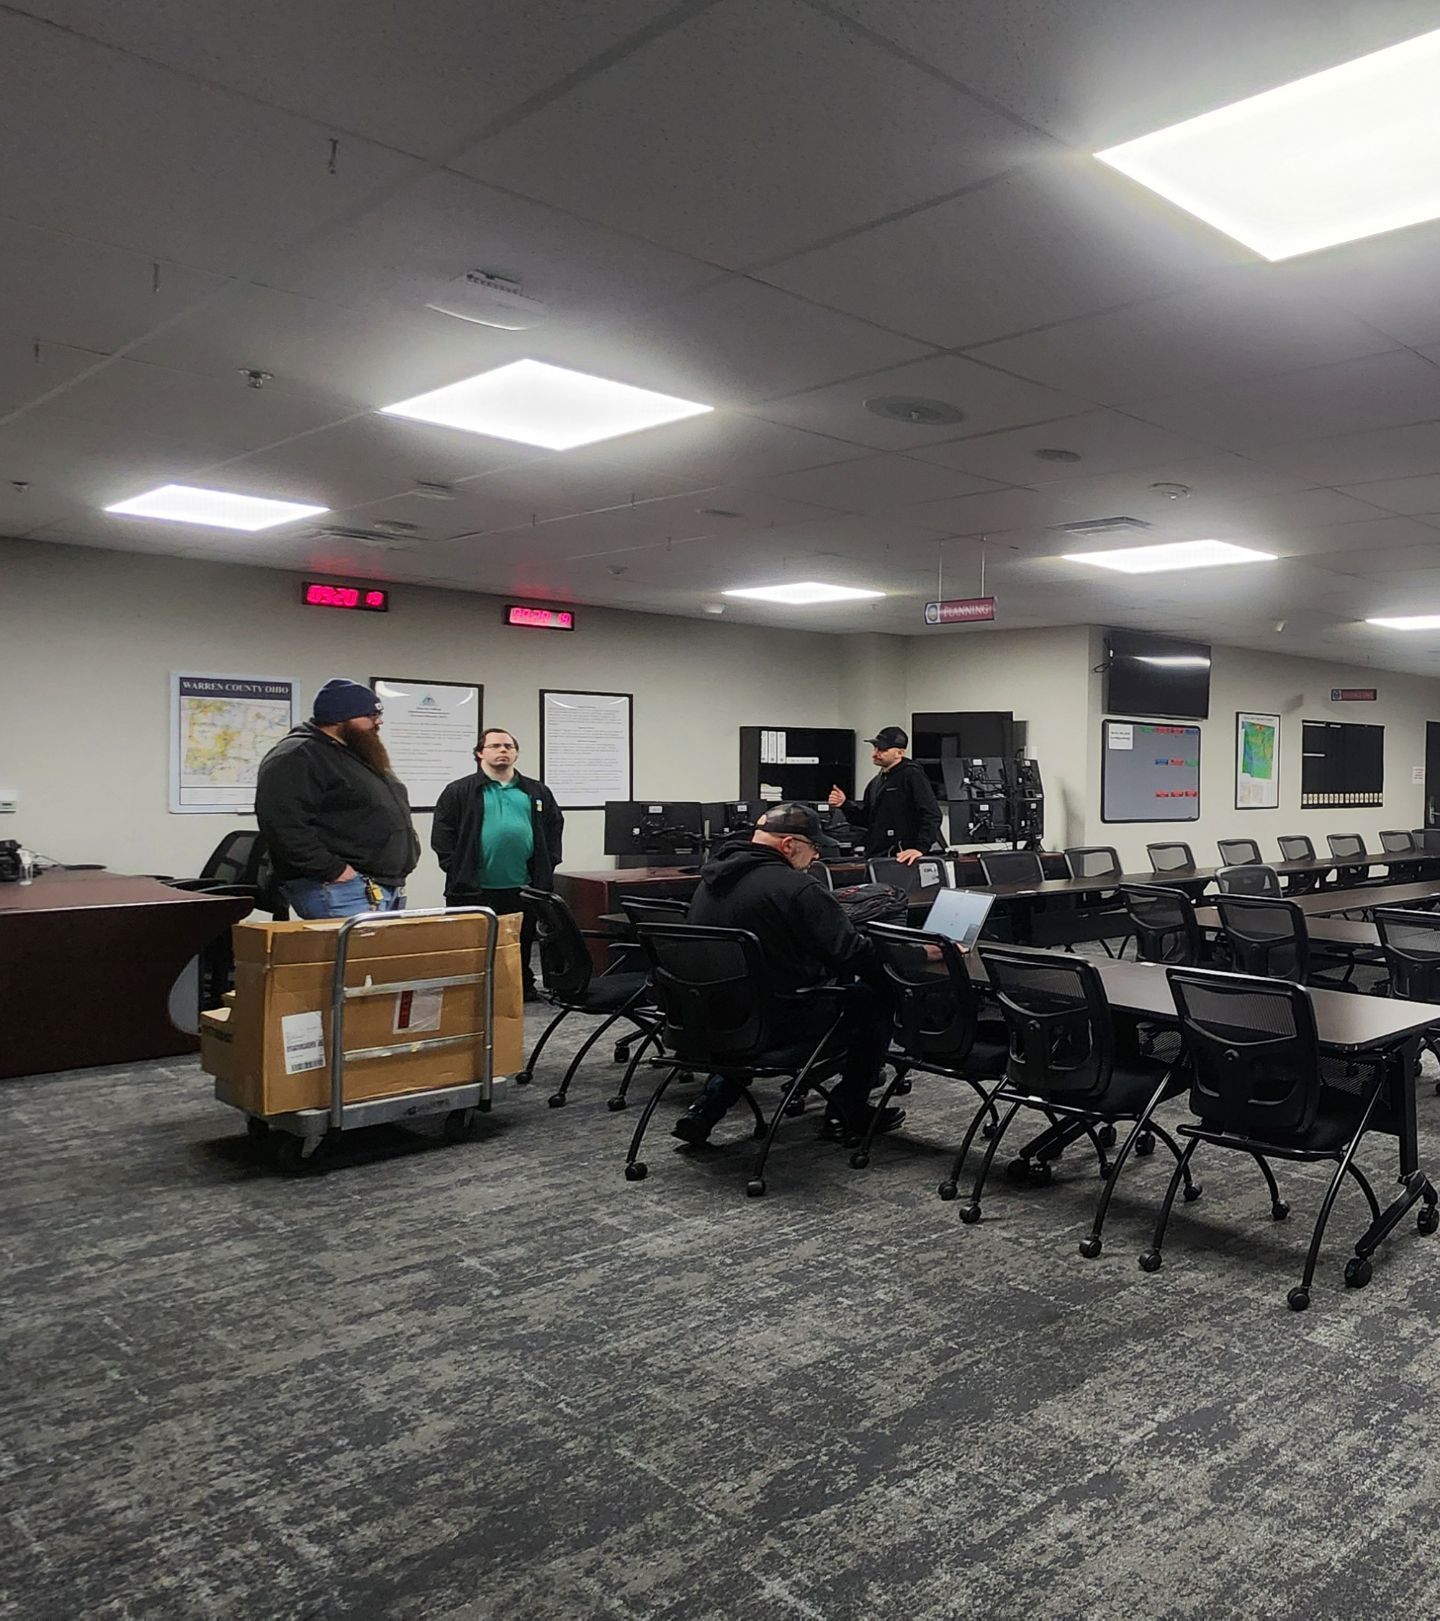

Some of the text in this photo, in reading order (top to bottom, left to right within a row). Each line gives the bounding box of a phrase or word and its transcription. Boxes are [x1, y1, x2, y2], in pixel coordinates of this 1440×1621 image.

[943, 604, 989, 618] PLANNING
[182, 681, 289, 694] WARREN COUNTY OHIO
